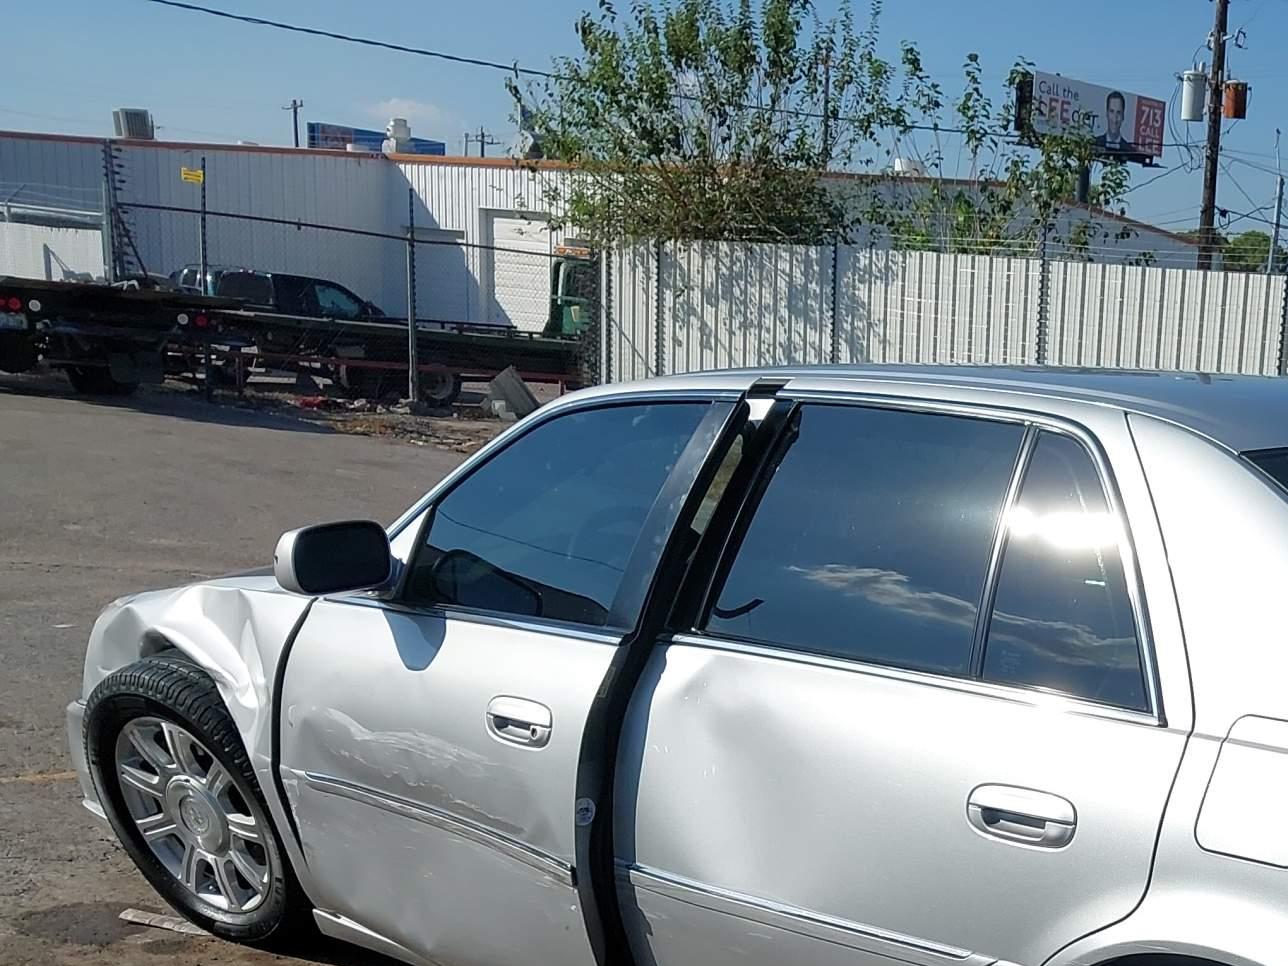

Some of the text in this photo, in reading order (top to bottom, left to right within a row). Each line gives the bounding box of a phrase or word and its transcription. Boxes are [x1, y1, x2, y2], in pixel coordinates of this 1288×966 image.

[1038, 80, 1080, 101] Call the
[1140, 105, 1162, 128] 713
[1139, 125, 1160, 138] CALL
[1138, 136, 1161, 155] LEE
